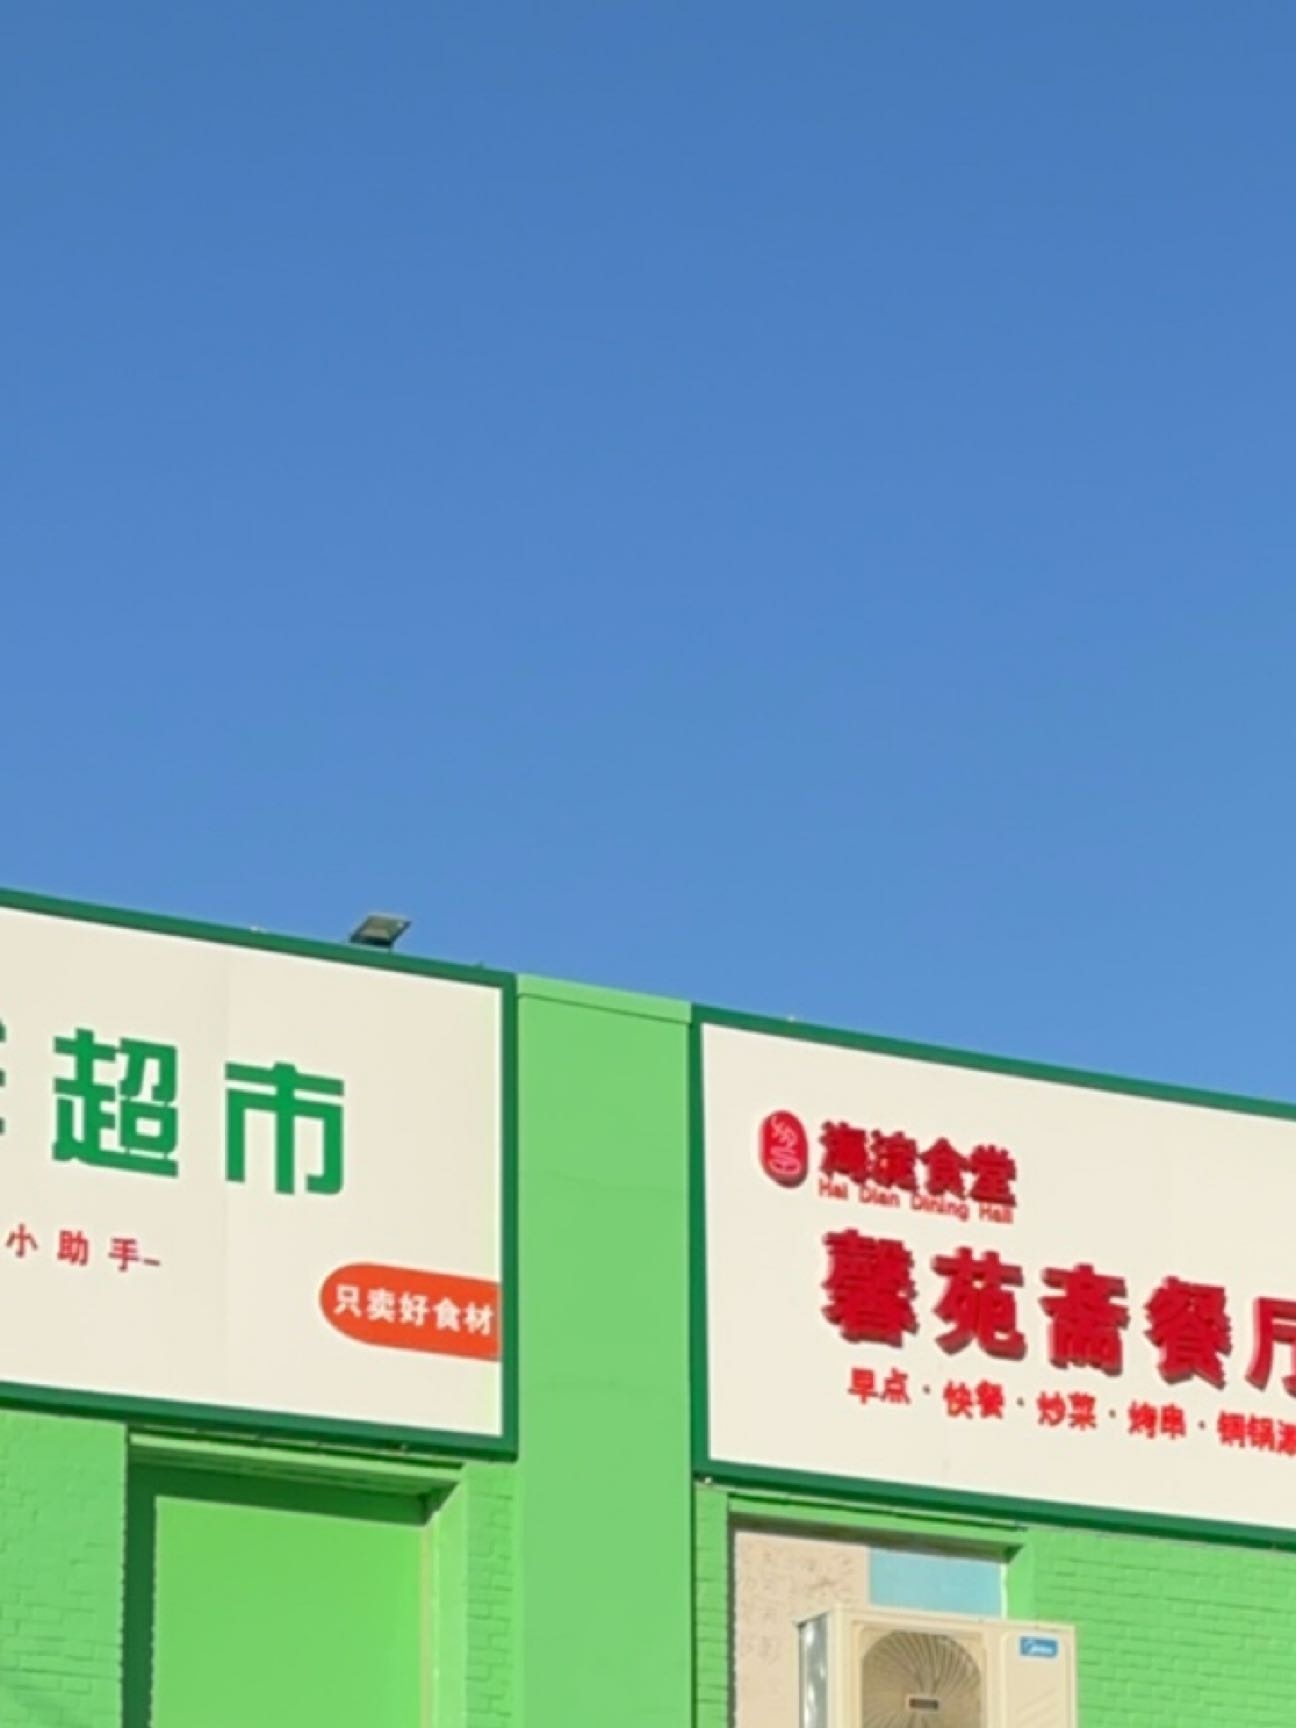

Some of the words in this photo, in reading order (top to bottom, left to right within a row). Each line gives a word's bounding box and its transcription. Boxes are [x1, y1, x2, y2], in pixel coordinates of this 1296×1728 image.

[0, 1020, 345, 1196] 超市
[819, 1121, 1017, 1207] 海淀食堂
[818, 1179, 849, 1200] Hai
[858, 1186, 901, 1207] Dian
[911, 1194, 970, 1222] Dining
[979, 1204, 1014, 1223] Hall
[333, 1284, 493, 1336] 只卖好食材
